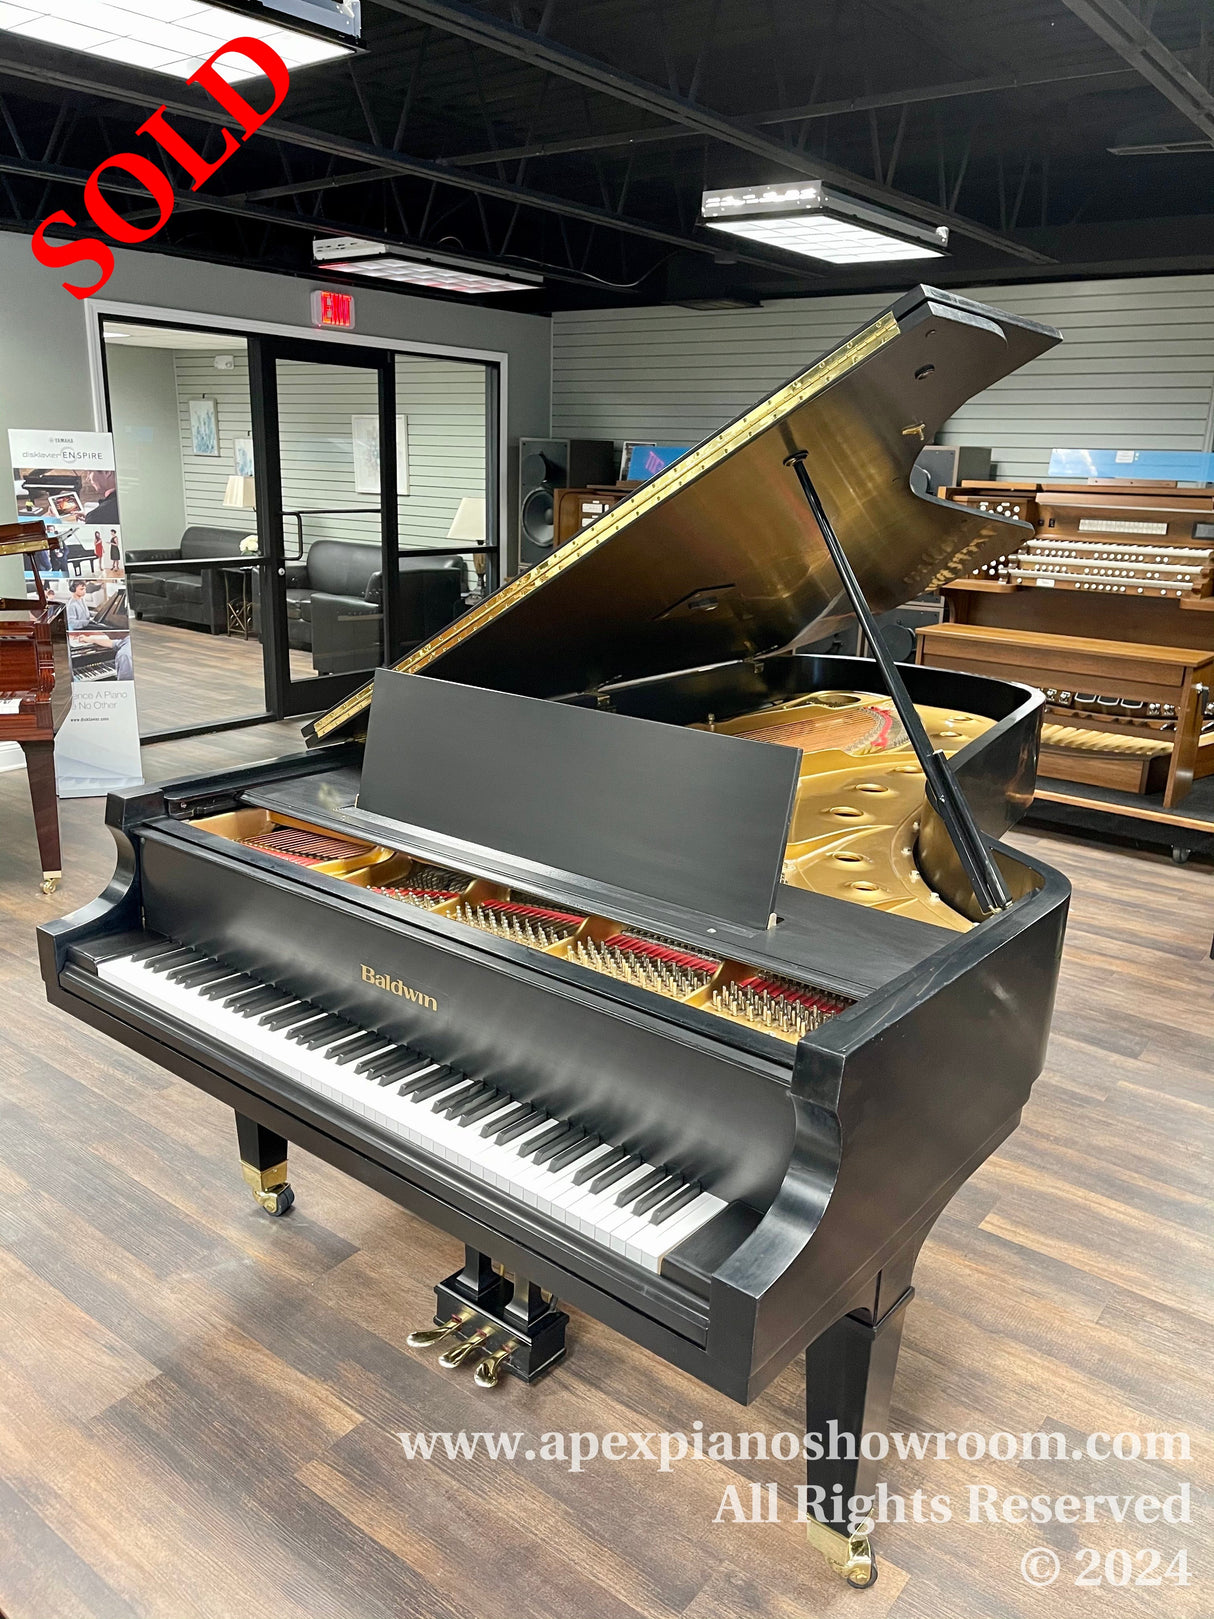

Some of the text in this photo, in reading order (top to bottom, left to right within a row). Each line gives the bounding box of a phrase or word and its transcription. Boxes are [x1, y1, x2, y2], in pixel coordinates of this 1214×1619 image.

[321, 291, 351, 327] EXIT
[62, 451, 103, 460] ENSPIRE
[95, 691, 102, 699] A
[104, 691, 127, 699] Piano
[94, 701, 117, 709] Other
[360, 963, 438, 1011] Baldwin
